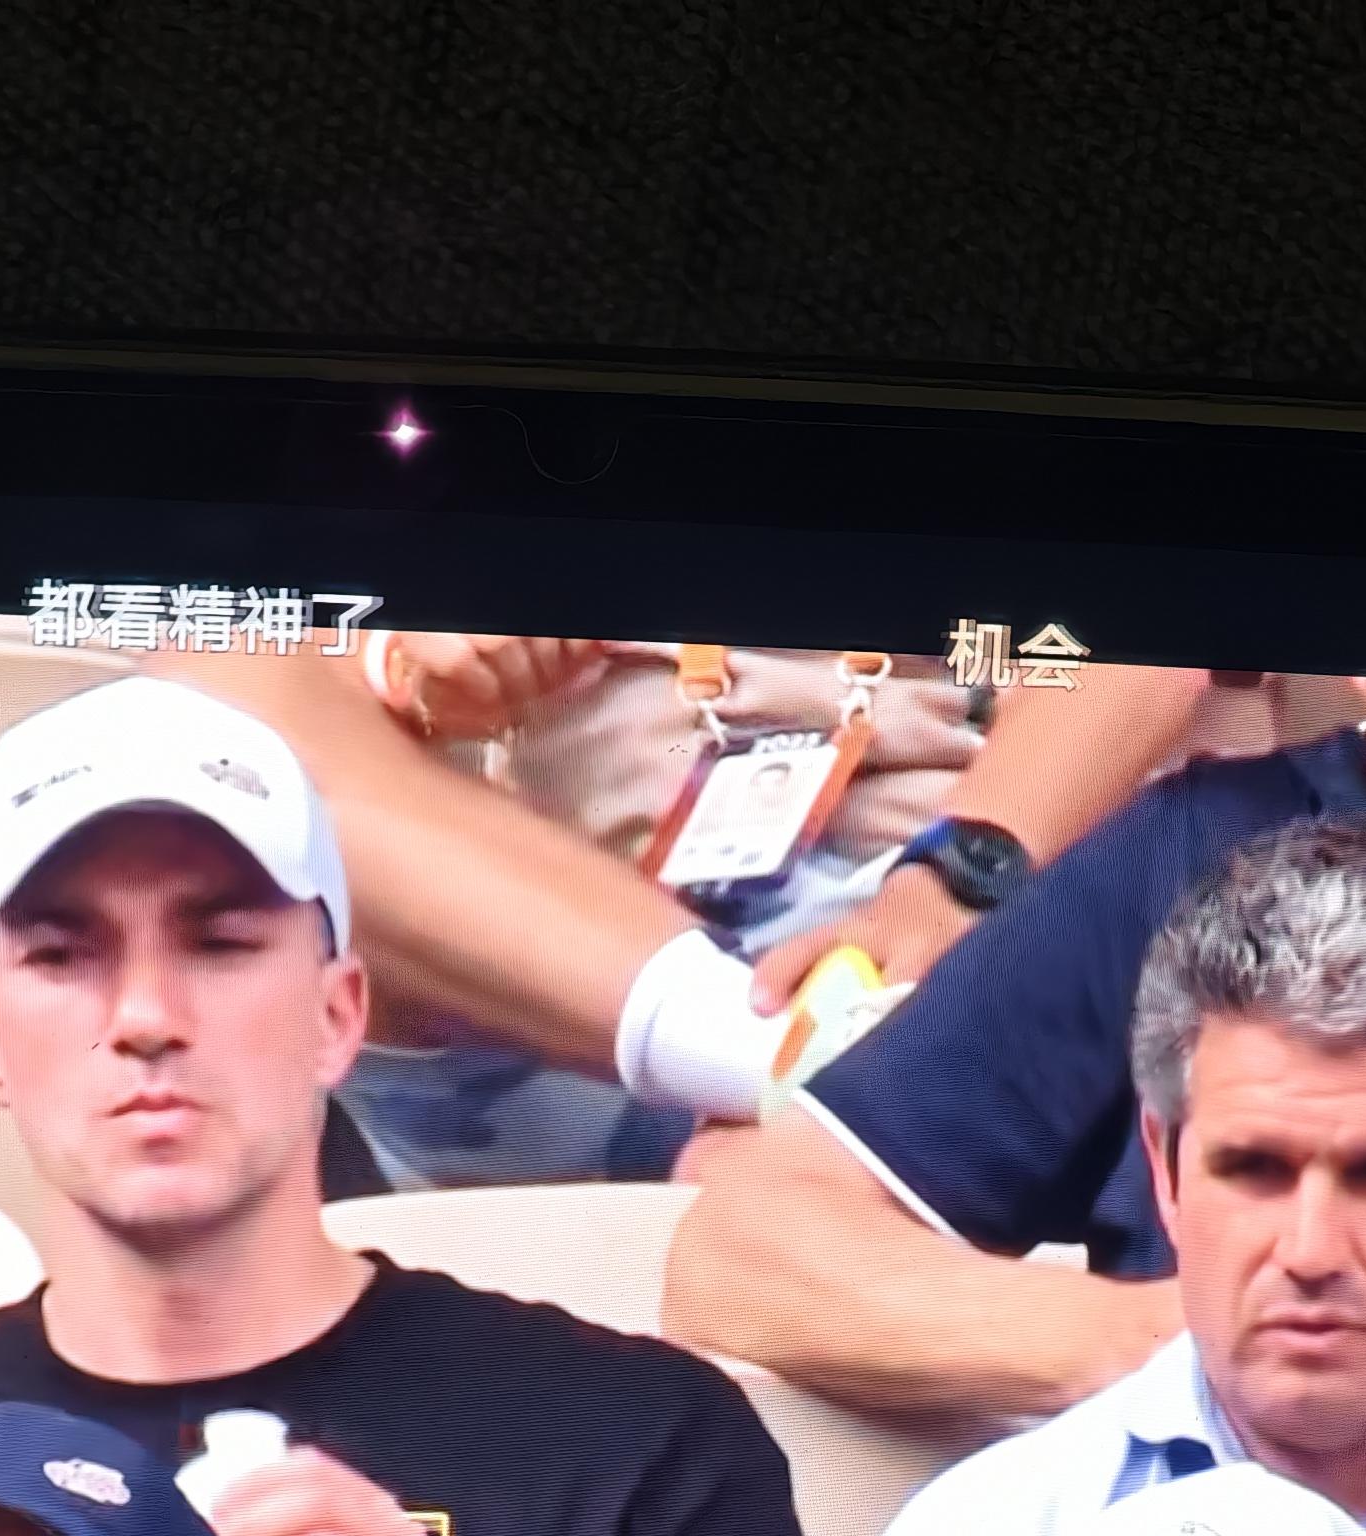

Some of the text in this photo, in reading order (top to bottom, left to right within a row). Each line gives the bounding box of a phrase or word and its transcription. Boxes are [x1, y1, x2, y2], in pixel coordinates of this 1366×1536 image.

[26, 577, 381, 656] 都看精神了
[945, 617, 1088, 692] 机会
